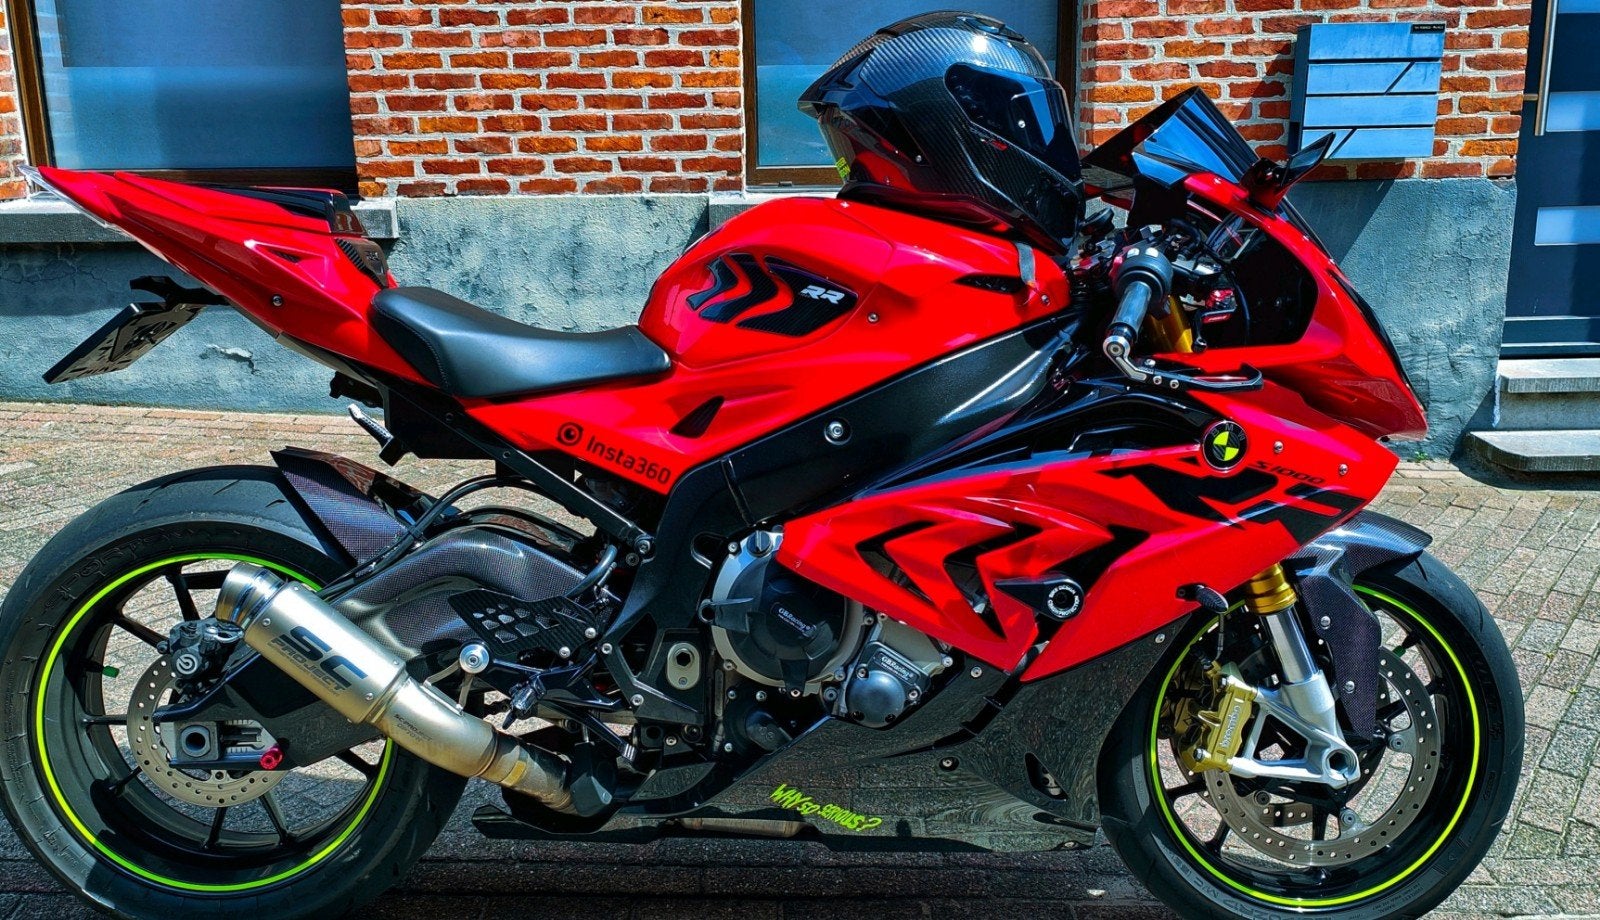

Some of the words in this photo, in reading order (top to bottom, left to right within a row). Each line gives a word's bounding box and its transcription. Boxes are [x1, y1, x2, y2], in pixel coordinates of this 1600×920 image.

[801, 285, 845, 304] RR
[586, 435, 671, 484] Insta360
[279, 625, 368, 688] SC
